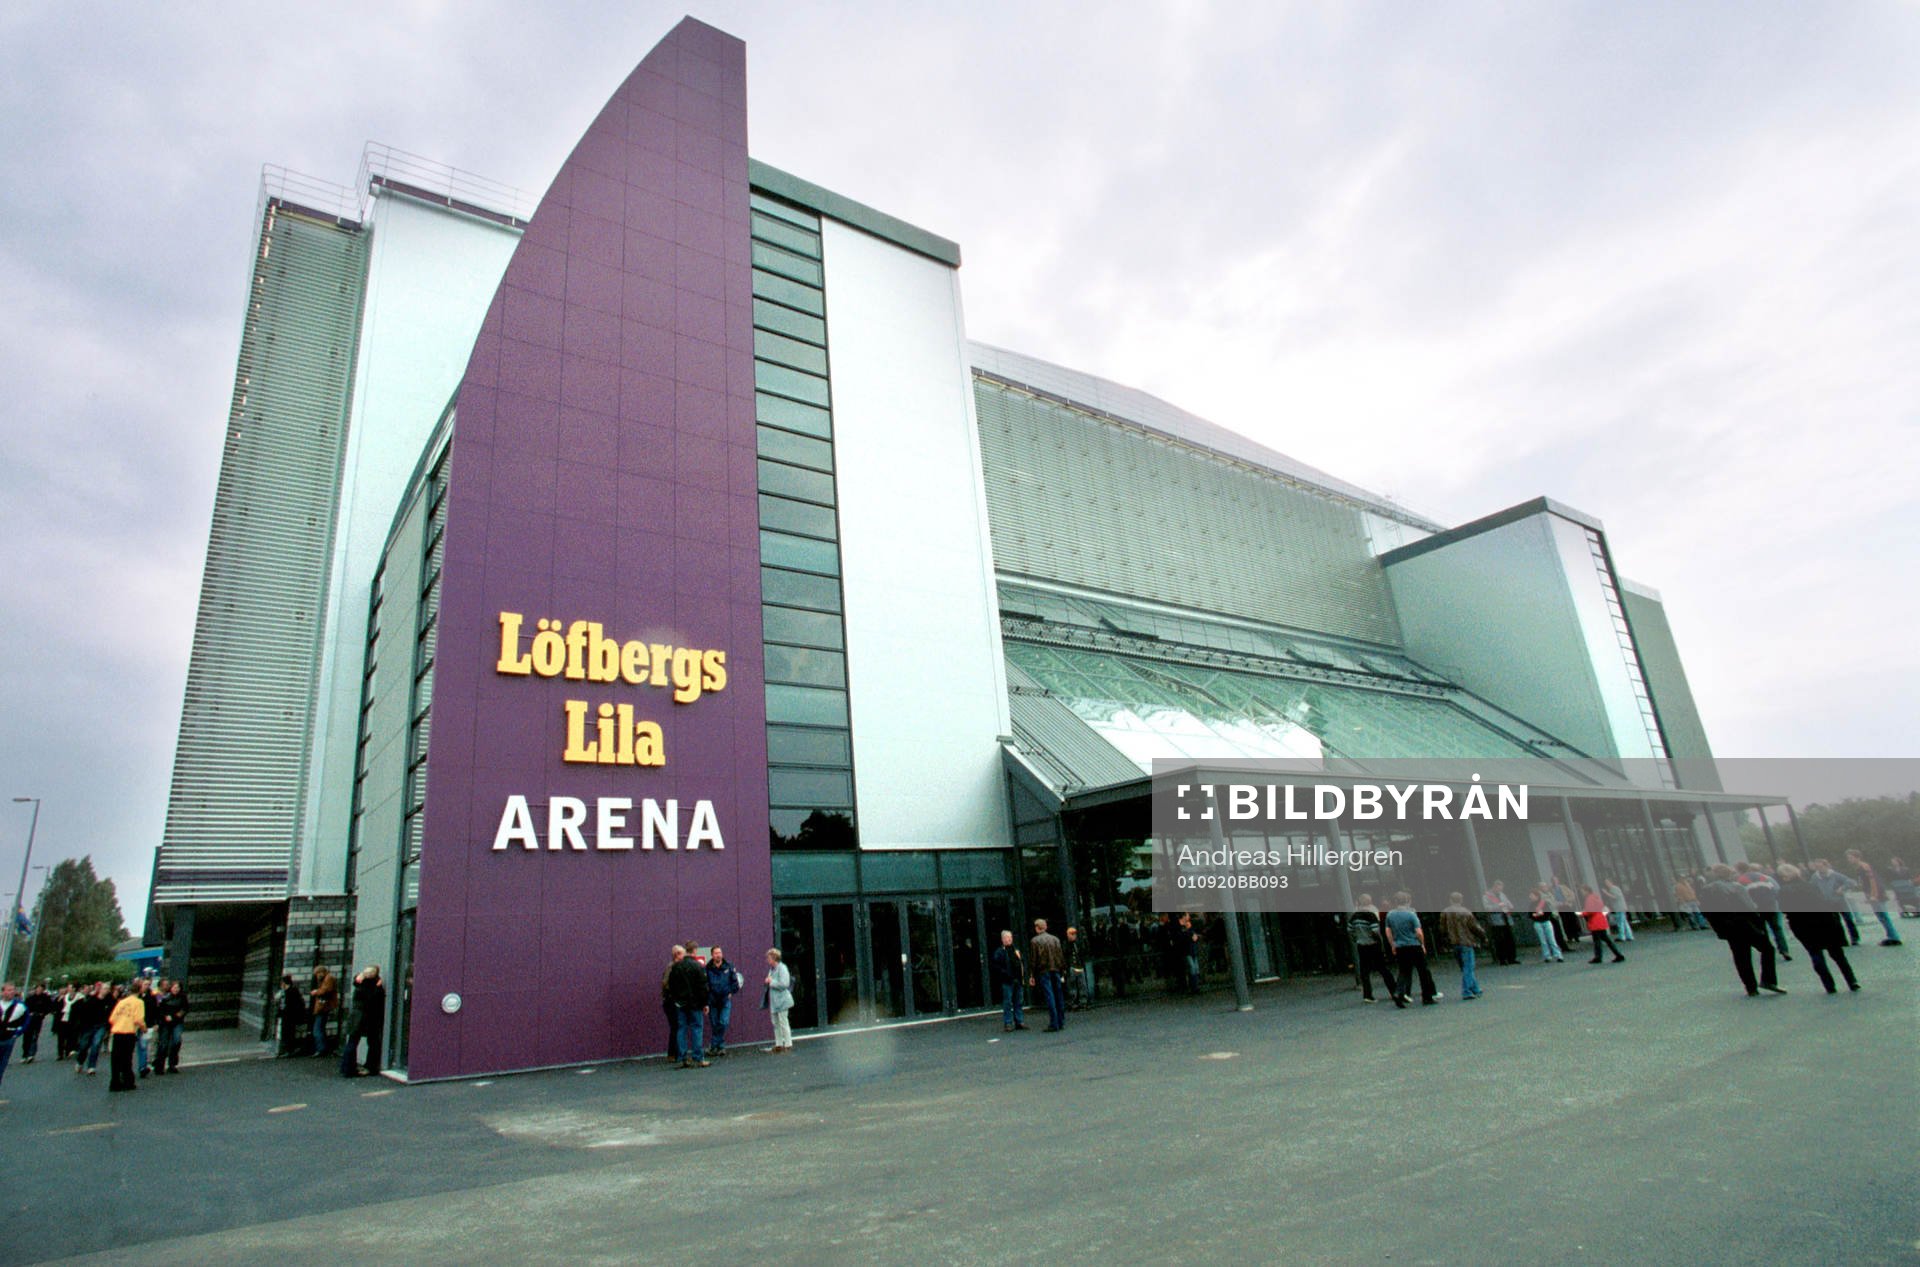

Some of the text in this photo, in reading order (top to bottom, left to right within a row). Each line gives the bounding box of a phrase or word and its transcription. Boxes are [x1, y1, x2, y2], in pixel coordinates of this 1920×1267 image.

[496, 611, 728, 703] Löfbergs
[563, 700, 666, 767] Lila
[492, 795, 725, 850] ARENA
